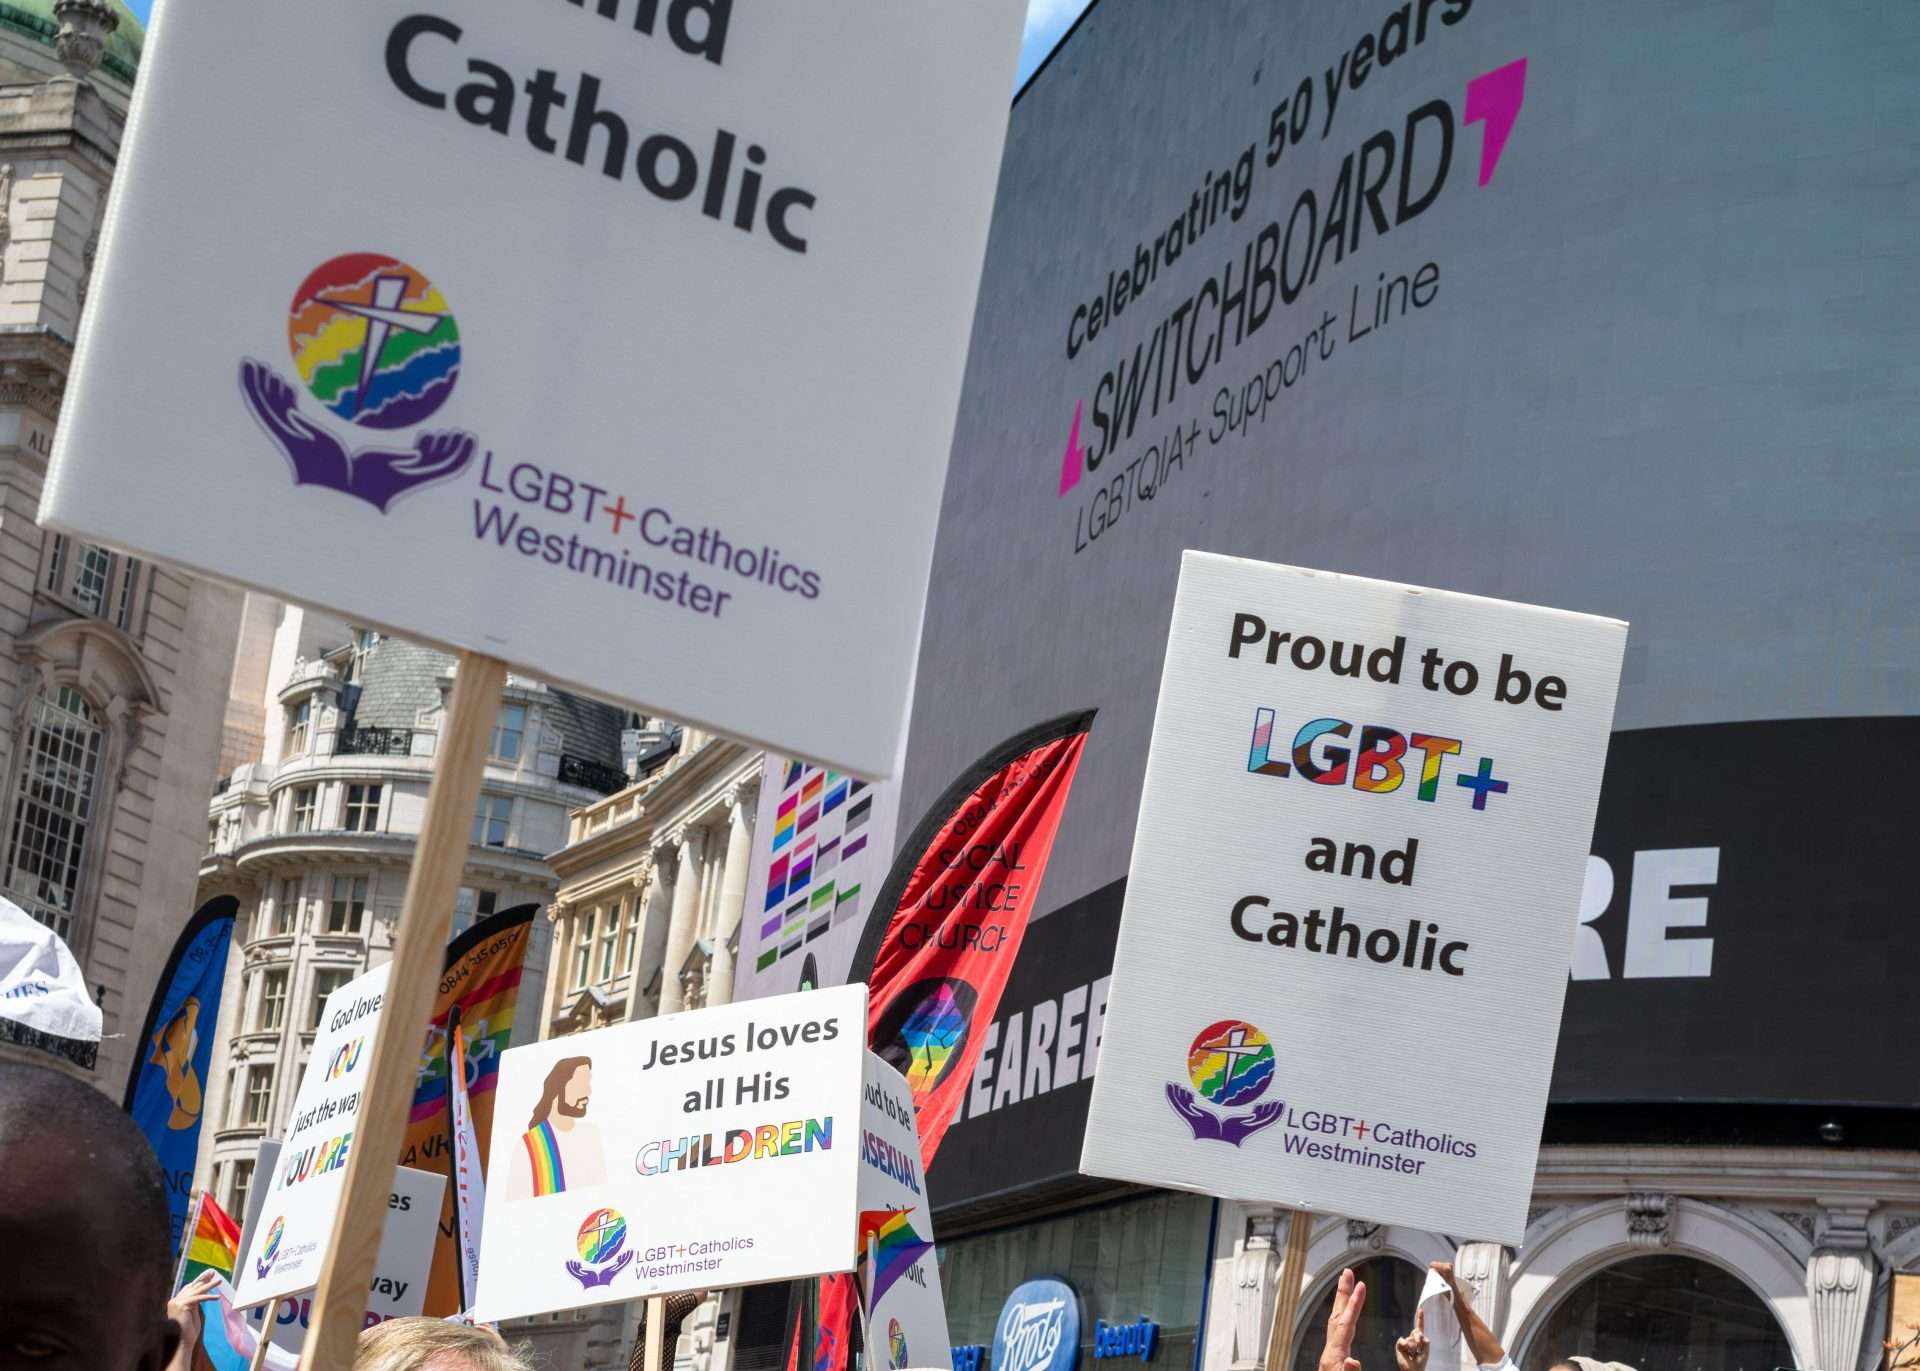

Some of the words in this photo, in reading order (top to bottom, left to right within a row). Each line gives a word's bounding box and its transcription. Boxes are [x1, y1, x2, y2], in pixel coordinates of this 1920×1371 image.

[385, 13, 816, 254] Catholic
[1266, 76, 1312, 168] 50
[1087, 98, 1454, 472] SWITCHBOARD
[1074, 419, 1201, 554] LGBTQIA+
[1209, 310, 1337, 446] Support
[1349, 262, 1440, 343] Line
[474, 499, 731, 618] Westminster
[1228, 612, 1406, 685] Proud
[1420, 647, 1479, 696] to
[1494, 653, 1568, 711] be
[1247, 706, 1509, 811] LGBT+
[1304, 837, 1419, 887] and
[1230, 895, 1469, 977] Catholic
[330, 999, 357, 1033] God
[642, 1032, 736, 1071] Jesus
[747, 1016, 839, 1053] loves
[325, 1035, 365, 1083] YOU
[290, 1106, 317, 1143] just
[316, 1098, 337, 1125] the
[682, 1077, 724, 1114] all
[735, 1071, 790, 1106] His
[884, 1090, 897, 1121] to
[896, 1096, 911, 1132] be
[278, 1146, 317, 1191] YOU
[311, 1132, 353, 1179] ARE
[635, 1116, 833, 1177] CHILDREN
[862, 1129, 921, 1196] ISEXUAL
[1283, 1133, 1426, 1175] Westminster
[634, 1257, 723, 1281] Westminster
